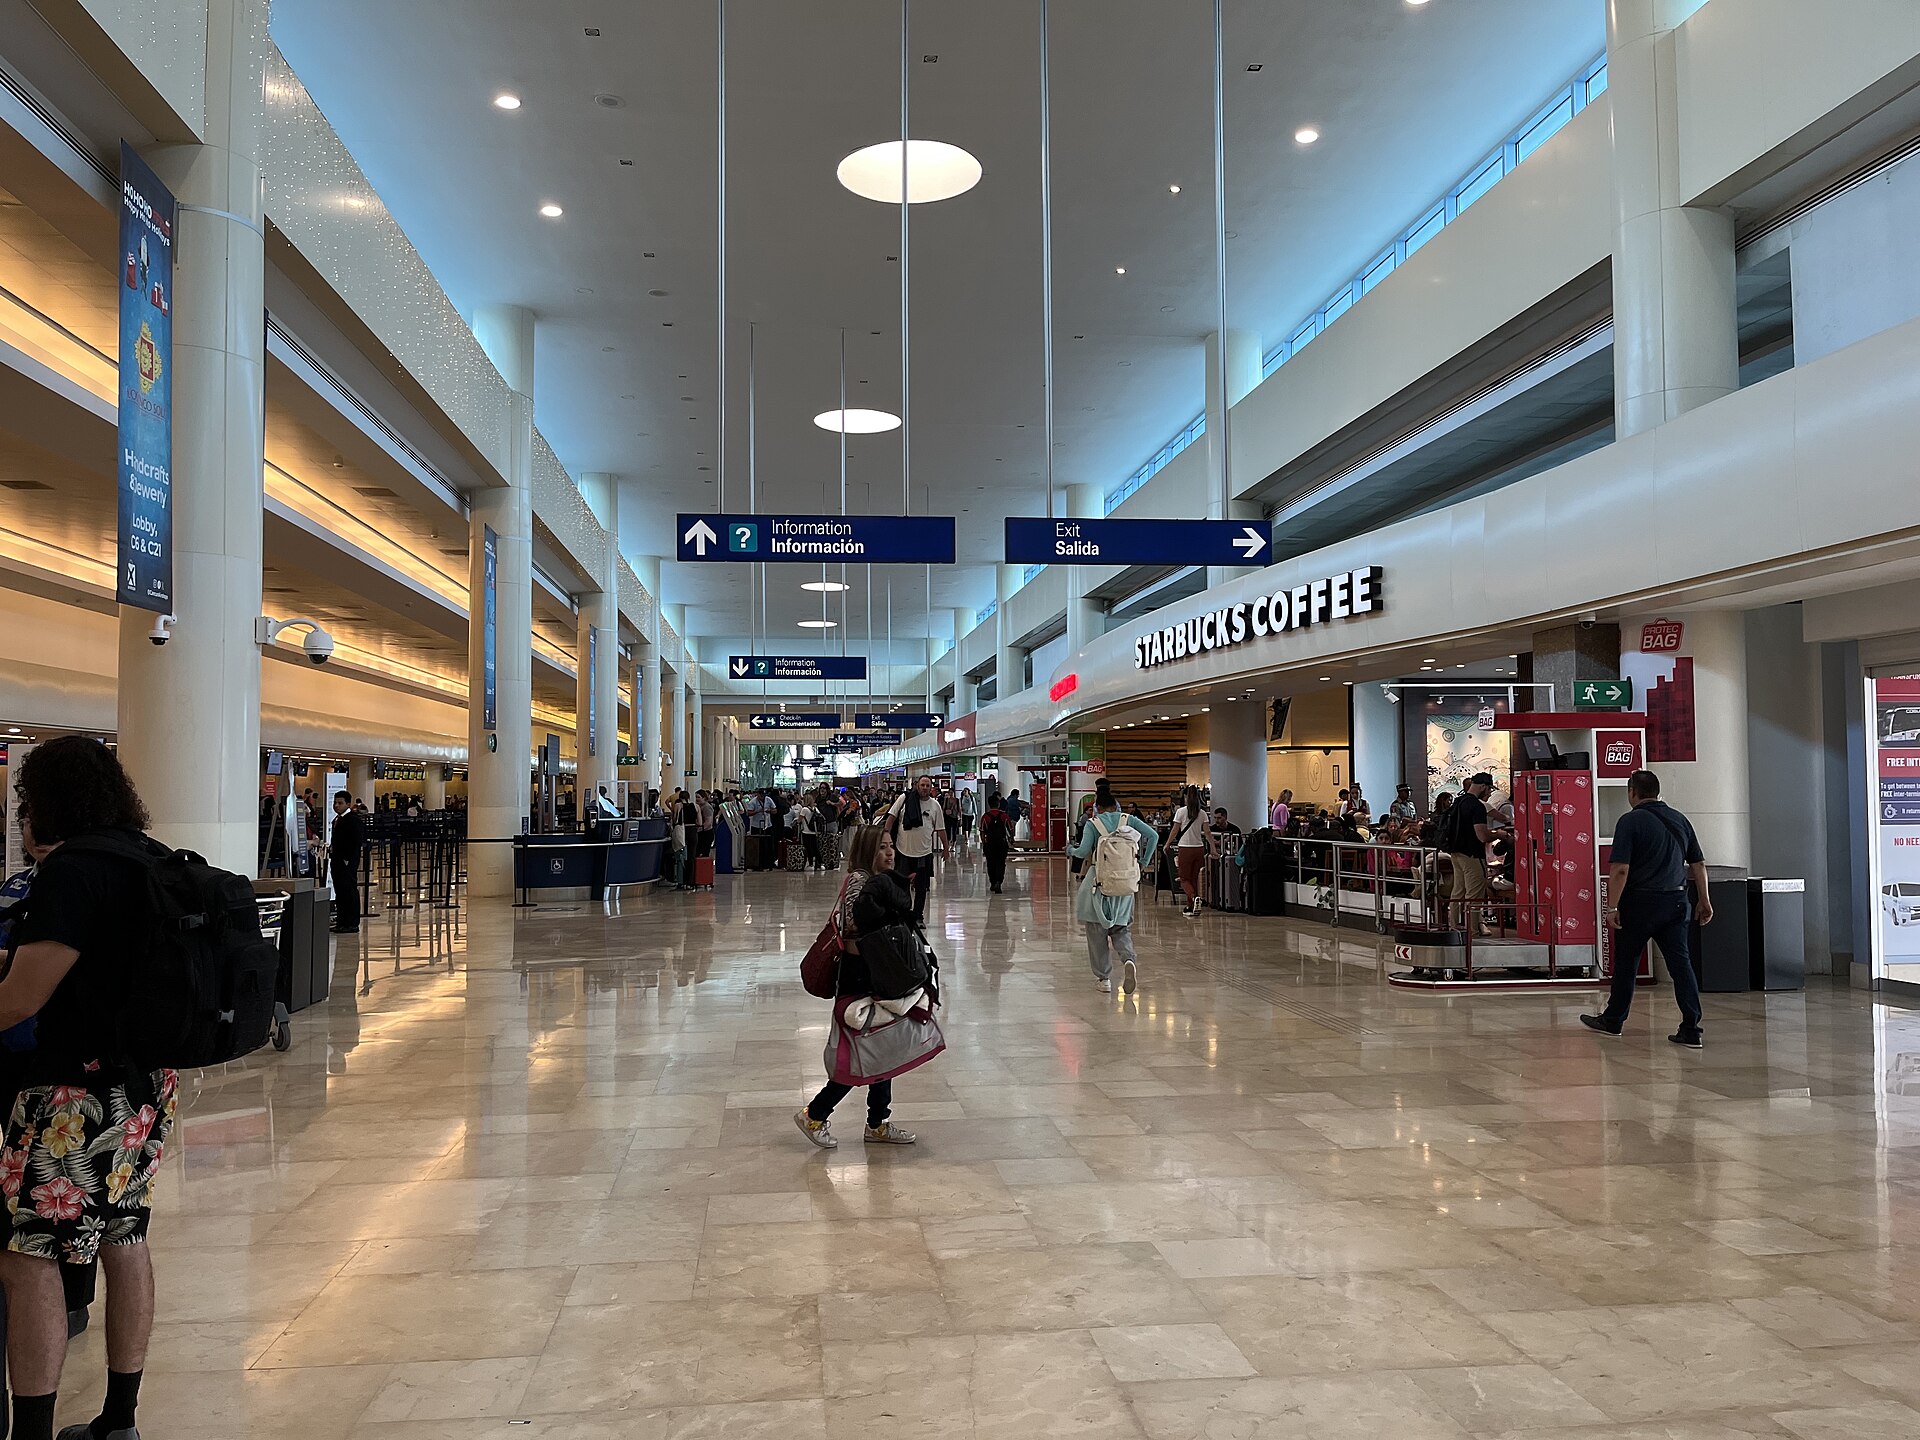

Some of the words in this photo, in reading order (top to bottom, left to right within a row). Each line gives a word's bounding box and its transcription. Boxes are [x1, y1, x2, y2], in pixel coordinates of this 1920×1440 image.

[132, 512, 158, 538] Lobby,
[771, 520, 852, 535] Information
[1056, 522, 1081, 537] Exit
[131, 534, 140, 551] C6
[140, 539, 147, 553] &
[147, 541, 162, 558] C21
[771, 538, 865, 554] Información
[1055, 541, 1100, 555] Salida
[1134, 602, 1247, 670] STARBUCKS
[1251, 566, 1376, 637] COFFEE
[1644, 625, 1679, 635] PROTEC
[1642, 634, 1678, 649] BAG
[775, 658, 816, 667] Information
[775, 667, 822, 676] Información
[1479, 717, 1493, 728] BAG
[1607, 752, 1630, 762] BAG
[1886, 757, 1905, 767] FREE
[1906, 757, 1920, 767] INT
[1087, 765, 1103, 773] BAG
[1894, 837, 1904, 846] NO
[1905, 837, 1920, 846] NEE
